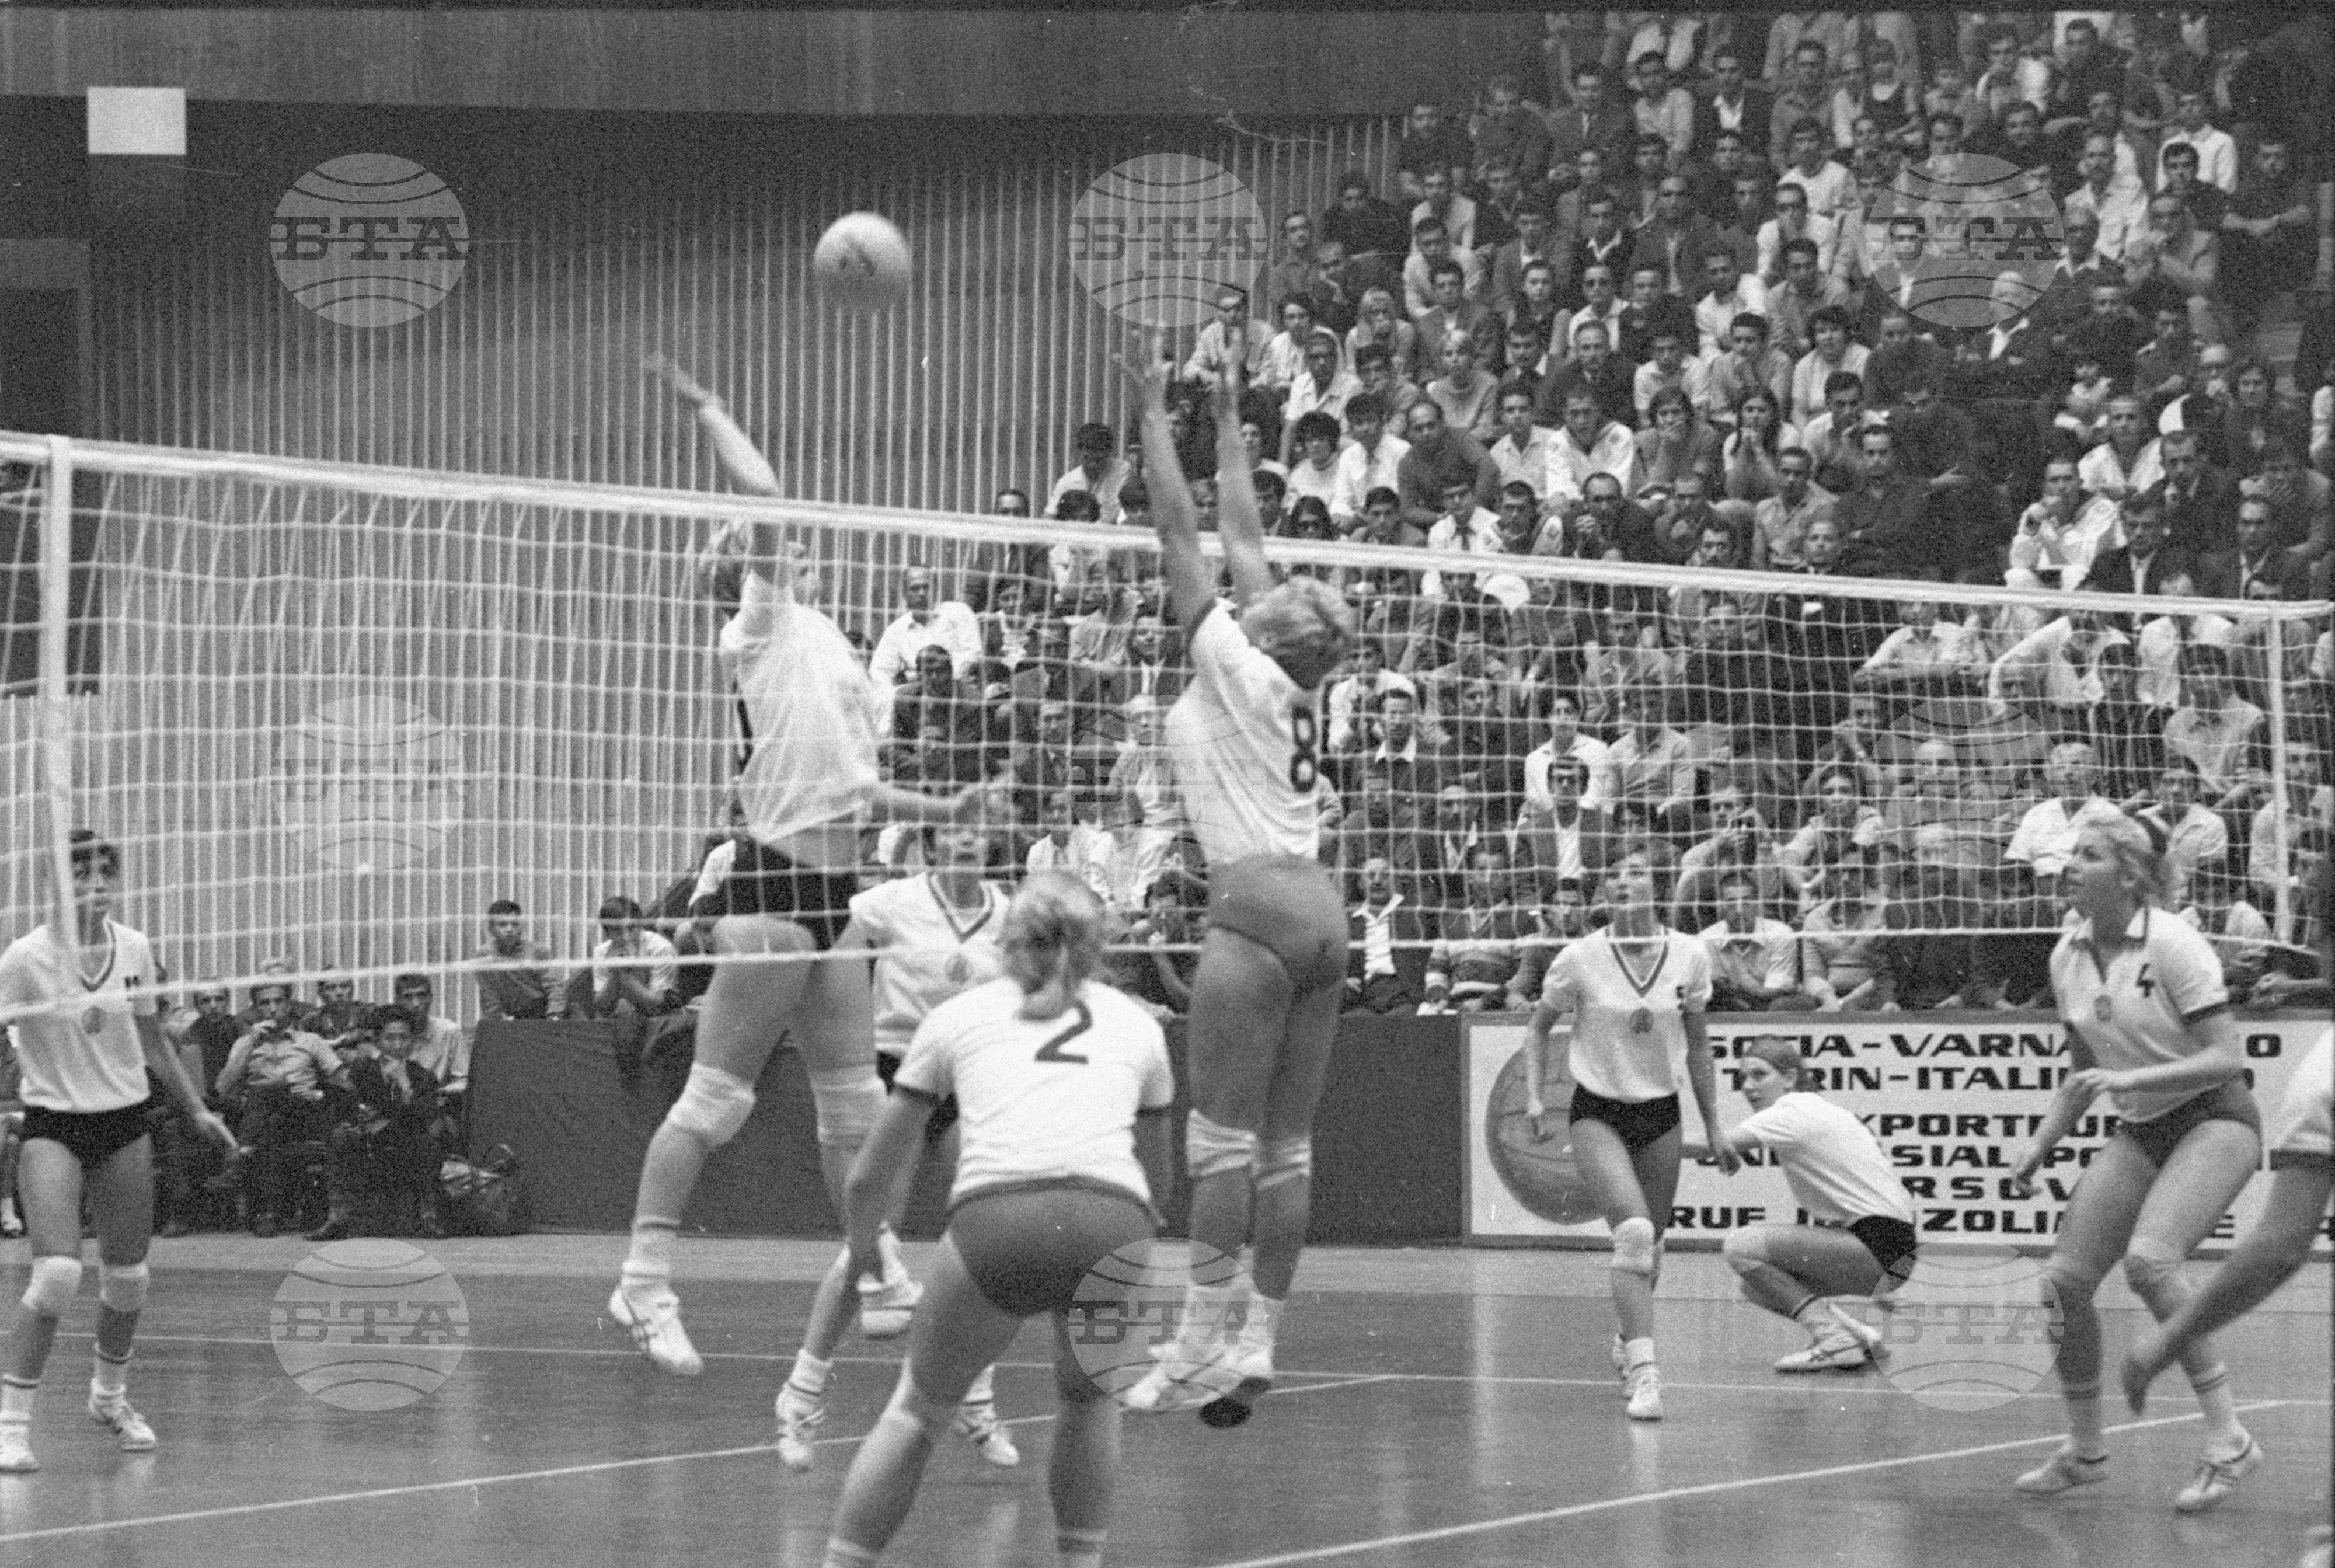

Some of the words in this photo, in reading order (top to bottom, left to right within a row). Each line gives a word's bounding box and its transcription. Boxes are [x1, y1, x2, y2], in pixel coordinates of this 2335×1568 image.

[1289, 705, 1317, 793] 8
[2135, 963, 2155, 998] 4
[1034, 999, 1092, 1064] 2
